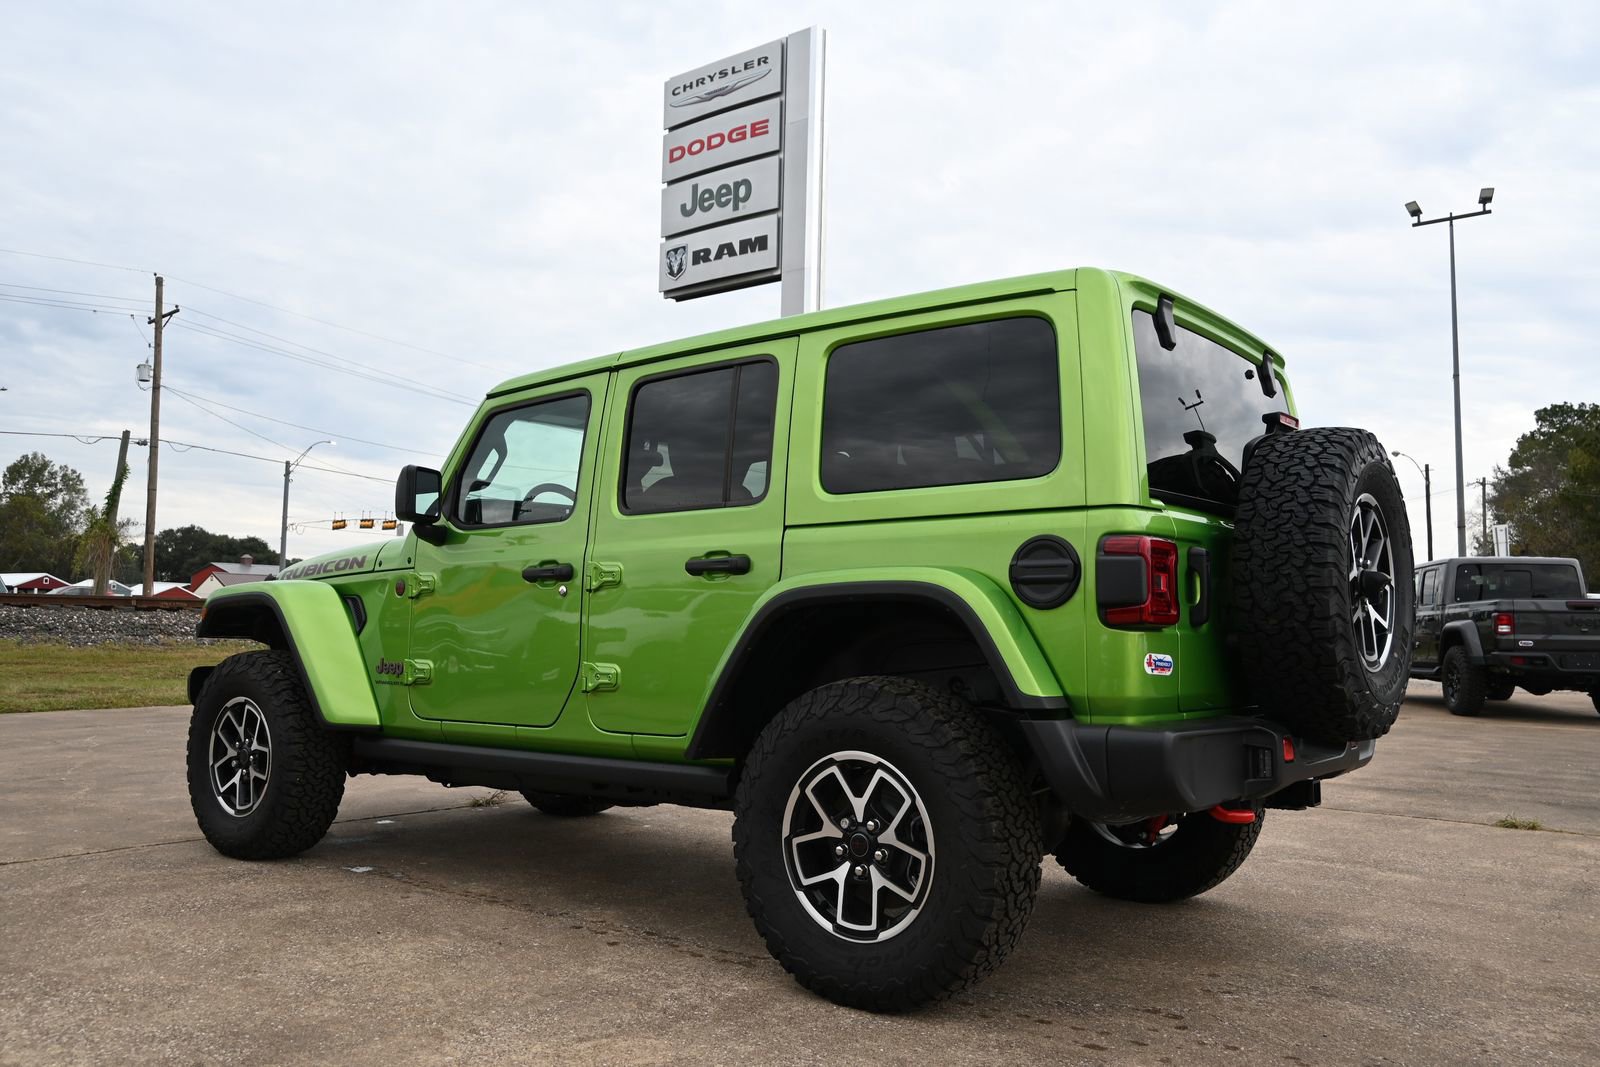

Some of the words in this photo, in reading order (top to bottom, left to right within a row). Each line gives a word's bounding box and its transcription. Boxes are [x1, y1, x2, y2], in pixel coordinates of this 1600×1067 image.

[671, 55, 769, 97] CHRYSLER
[668, 118, 770, 164] DODGE
[680, 178, 752, 217] Jeep
[692, 234, 768, 266] RAM
[281, 555, 367, 580] RUBICON
[376, 656, 404, 678] Jeep
